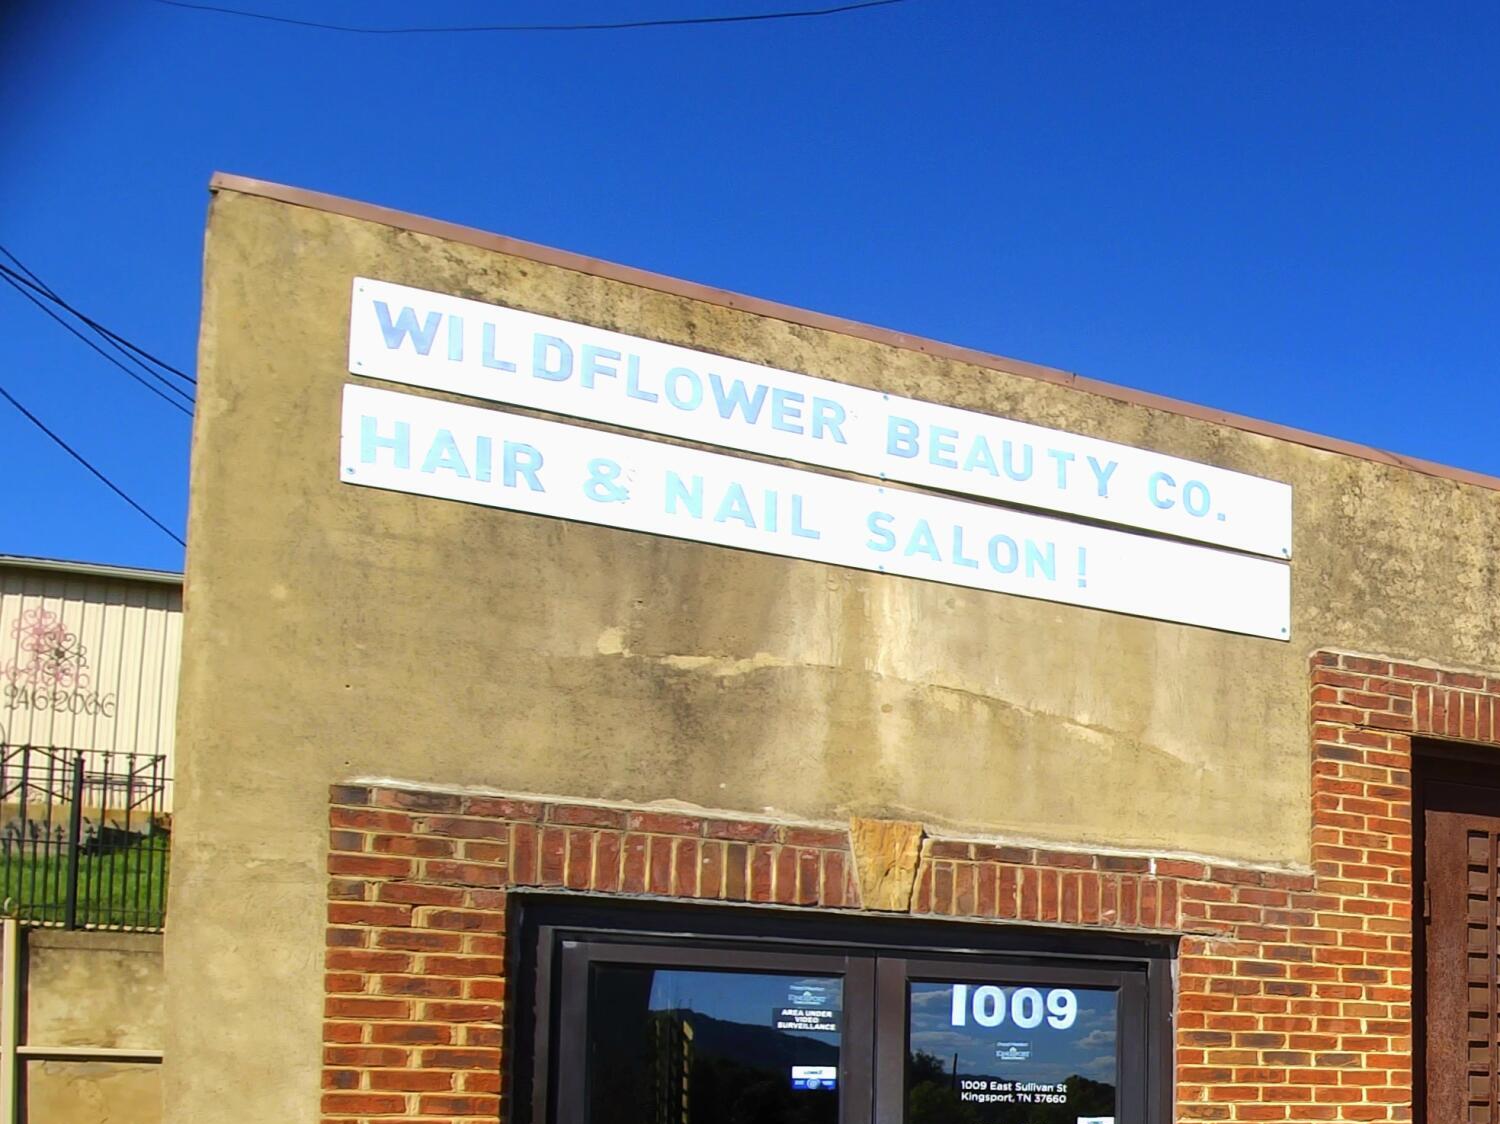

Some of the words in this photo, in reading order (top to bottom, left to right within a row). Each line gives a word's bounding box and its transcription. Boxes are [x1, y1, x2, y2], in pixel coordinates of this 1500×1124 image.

[372, 300, 848, 445] WILDFLOWER
[885, 416, 1118, 499] BEAUTY
[1148, 471, 1228, 523] CO.
[359, 415, 546, 492] HAIR
[583, 458, 630, 504] &
[664, 465, 821, 541] NAIL
[866, 511, 1089, 588] SALON!
[952, 984, 1078, 1029] 1009
[777, 1022, 836, 1030] SURVEILLANCE
[961, 1080, 987, 1091] 1009
[990, 1081, 1012, 1091] East
[1015, 1082, 1054, 1092] Sullivan
[1057, 1083, 1067, 1093] St
[961, 1092, 1015, 1103] Kingsport,
[1017, 1094, 1032, 1103] TN
[1034, 1094, 1067, 1103] 37660
